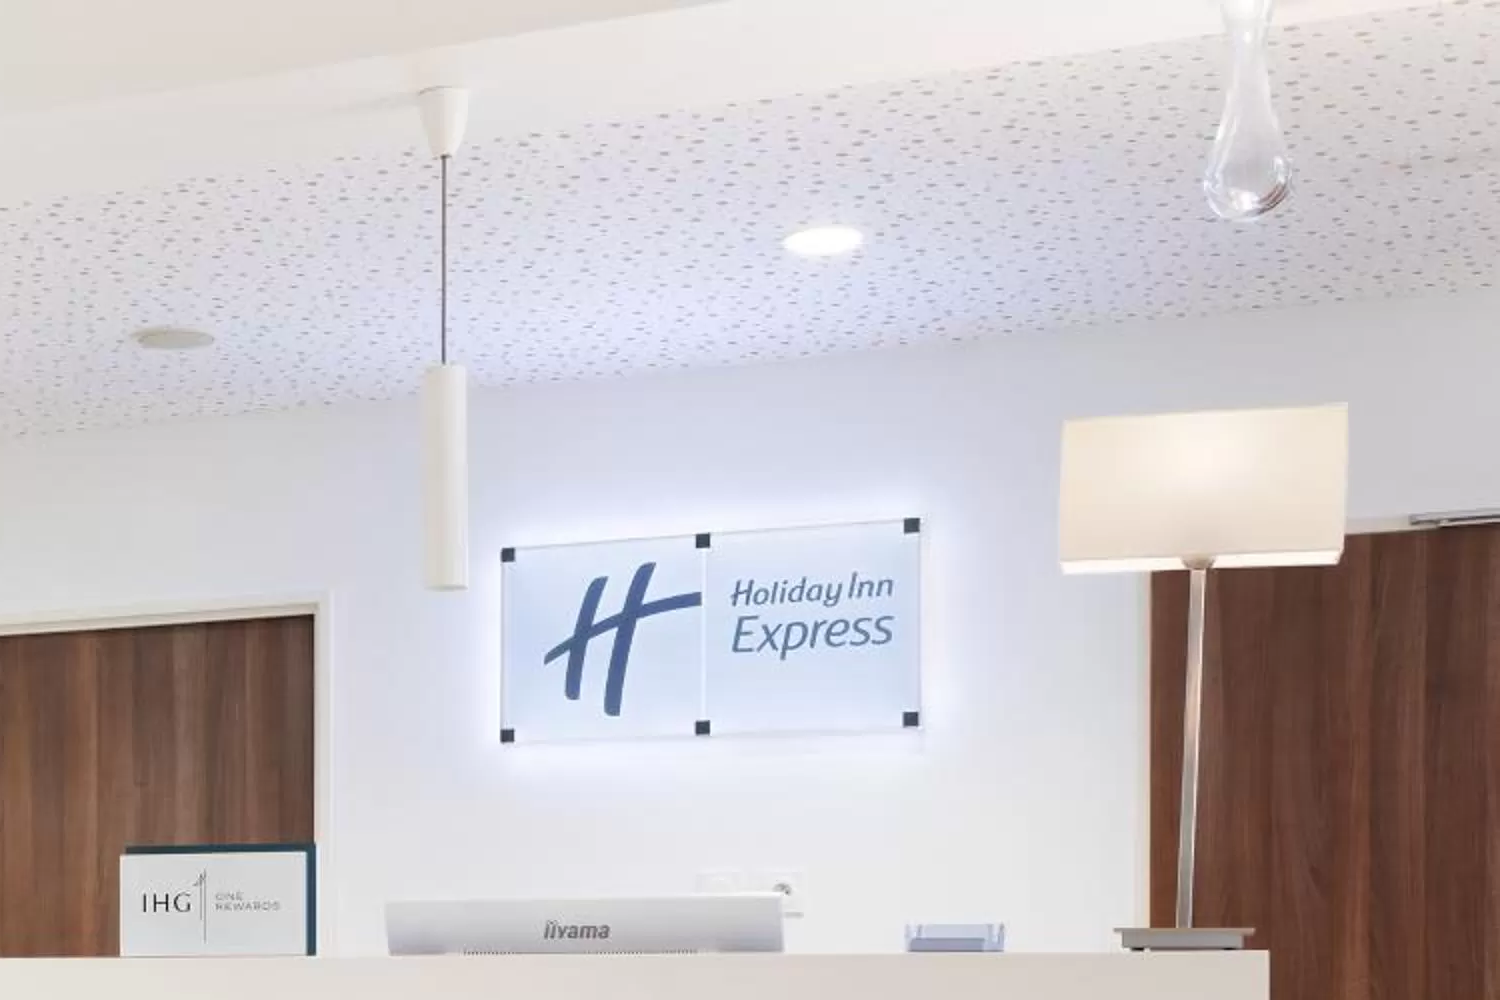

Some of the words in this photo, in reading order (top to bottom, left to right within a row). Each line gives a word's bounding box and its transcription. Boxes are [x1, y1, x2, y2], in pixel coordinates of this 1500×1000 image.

[730, 576, 842, 608] Holiday
[848, 571, 895, 599] Inn
[730, 615, 895, 660] Express
[142, 892, 192, 913] IHG
[214, 892, 244, 901] ONE
[214, 901, 281, 912] REWARDS
[543, 919, 610, 940] iiyama
